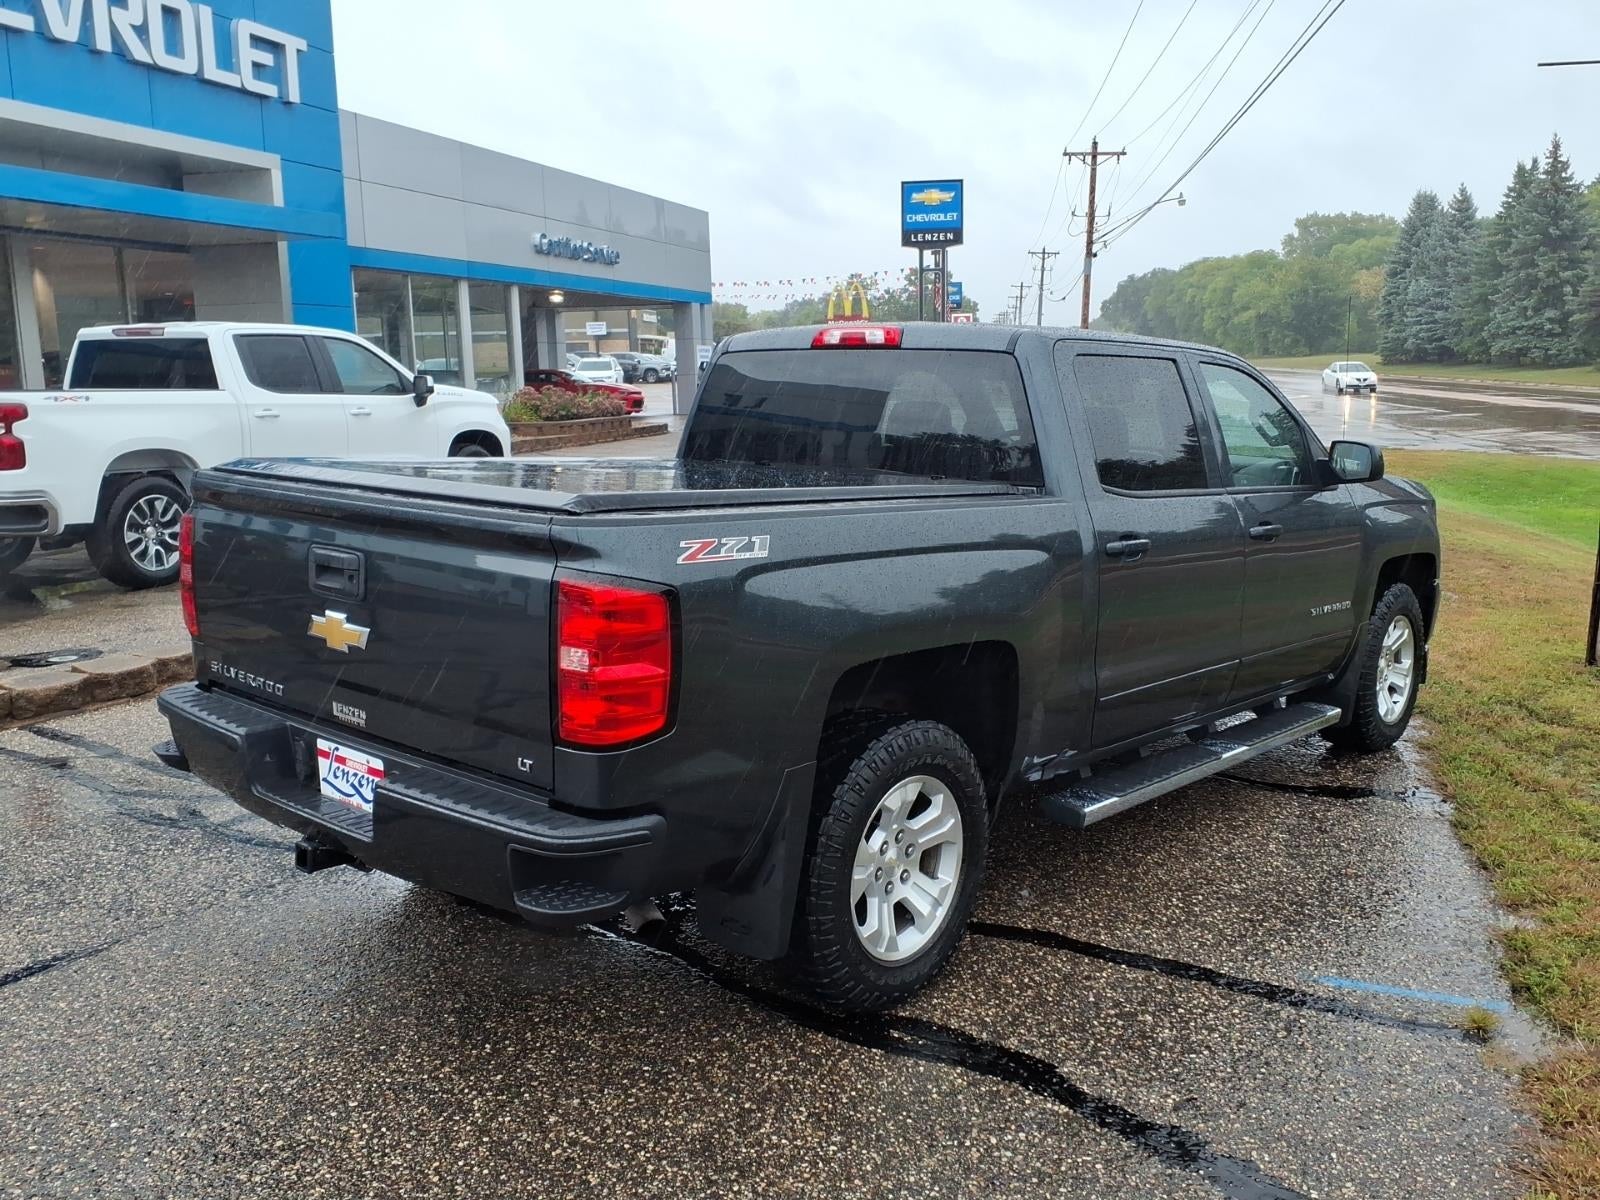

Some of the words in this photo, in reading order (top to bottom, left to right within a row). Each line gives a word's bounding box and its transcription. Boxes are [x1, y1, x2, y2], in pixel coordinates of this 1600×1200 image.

[0, 0, 308, 104] VROLET
[906, 212, 958, 222] CHEVROLET
[533, 232, 582, 260] Certified
[582, 241, 620, 266] Service
[911, 232, 954, 241] LENZEN
[676, 535, 770, 565] Z71
[1310, 600, 1352, 616] SILVERADO
[209, 660, 285, 697] SILVERADO
[332, 700, 367, 721] LENZEN
[322, 746, 376, 804] Lenzen
[517, 757, 533, 773] LT
